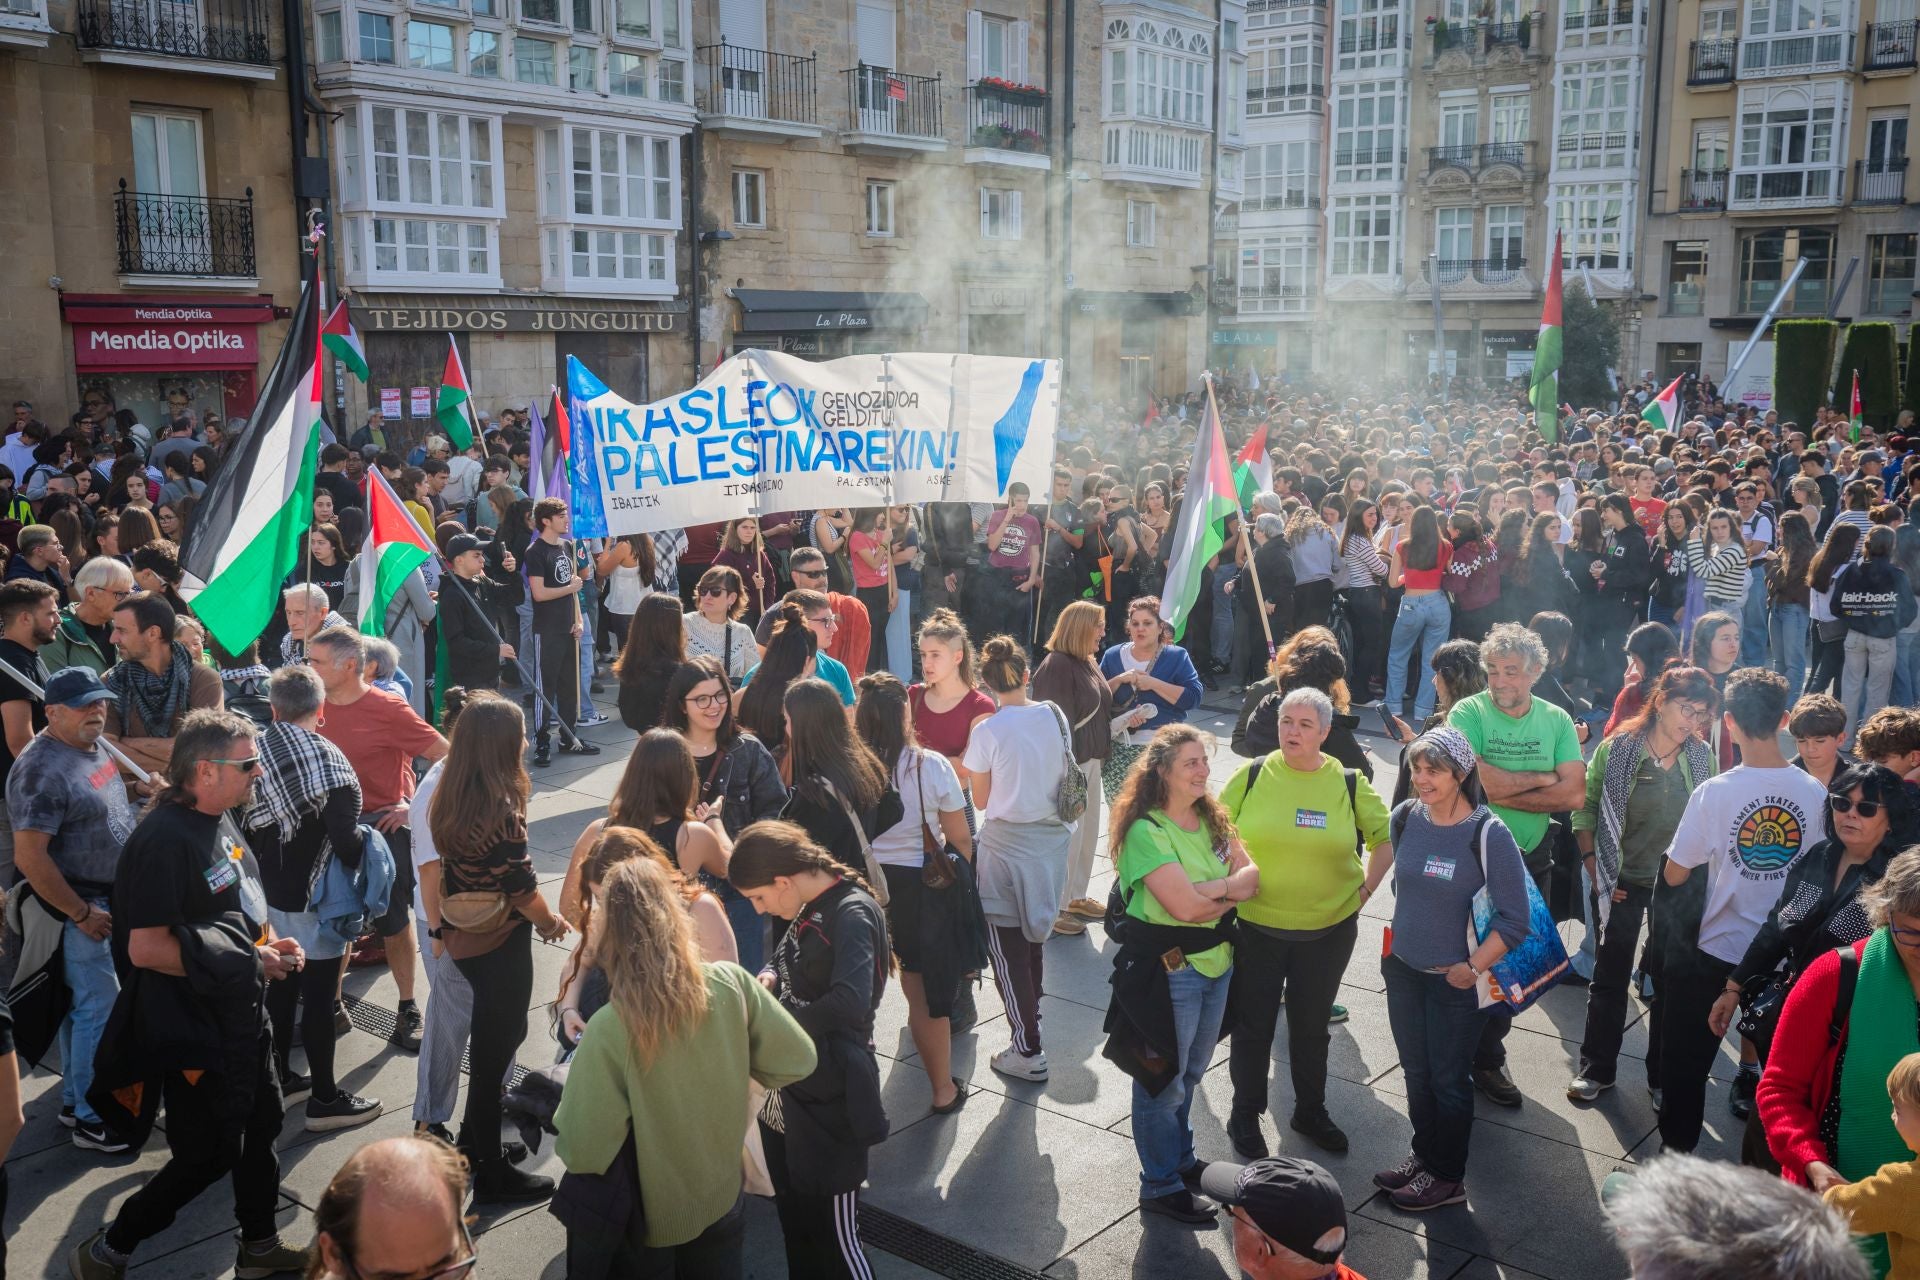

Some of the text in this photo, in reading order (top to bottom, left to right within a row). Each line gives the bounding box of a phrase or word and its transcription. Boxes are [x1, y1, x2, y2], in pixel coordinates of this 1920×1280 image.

[135, 308, 213, 321] Mendia Optika
[368, 310, 675, 331] TEJIDOS JUNGUITU
[815, 313, 868, 327] La Plaza
[90, 329, 245, 354] Mendia Optika
[782, 337, 816, 351] Plaza
[822, 390, 919, 409] GENOZIDIOA
[594, 380, 822, 443] IKASLEOK
[823, 408, 895, 427] GELDITU!
[602, 428, 960, 491] PALESTINAREKIN!
[836, 476, 893, 487] PALESTINA
[926, 474, 952, 486] ASKE
[611, 494, 661, 510] IBAITIK
[1840, 591, 1899, 603] laid-back
[1729, 798, 1761, 836] ELEMENT
[1728, 846, 1741, 868] WIND
[1764, 871, 1786, 881] FIRE
